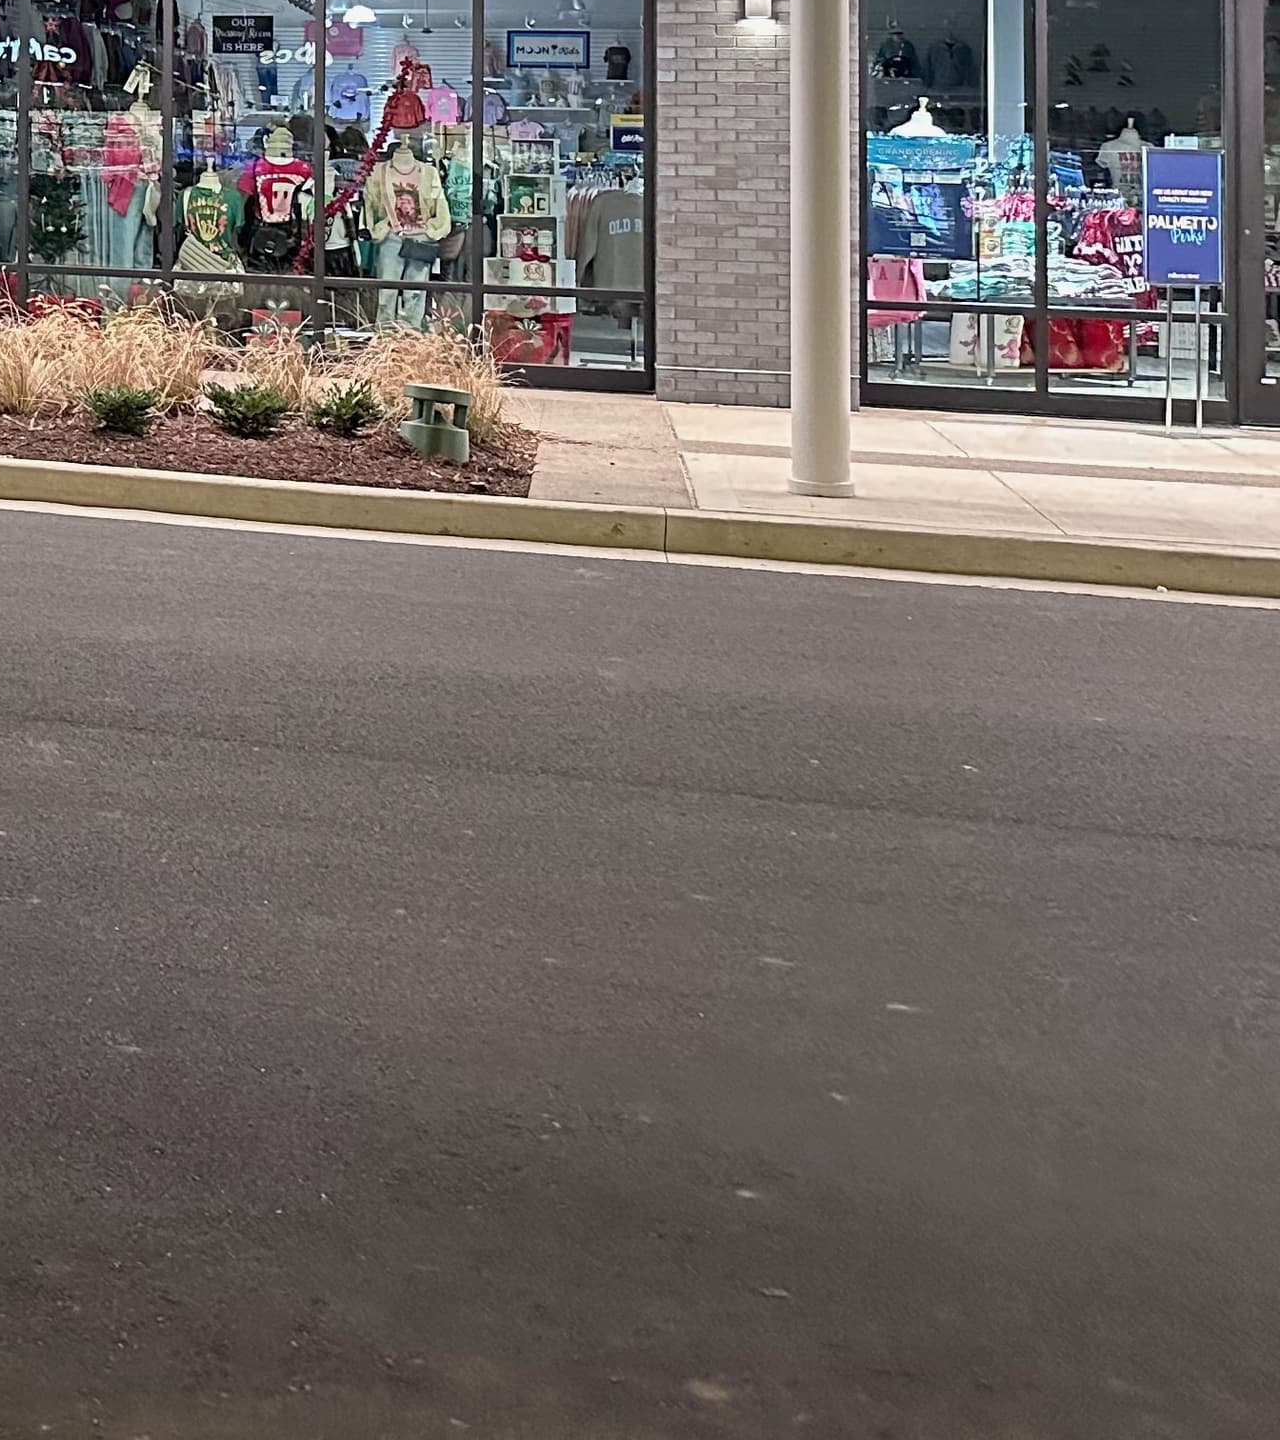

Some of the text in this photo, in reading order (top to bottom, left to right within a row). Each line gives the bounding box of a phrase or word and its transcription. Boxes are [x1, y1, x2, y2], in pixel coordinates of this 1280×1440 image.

[231, 18, 255, 27] OUR
[222, 42, 264, 52] IS HERE
[608, 218, 631, 235] OLD
[1148, 214, 1218, 231] PALMETTO
